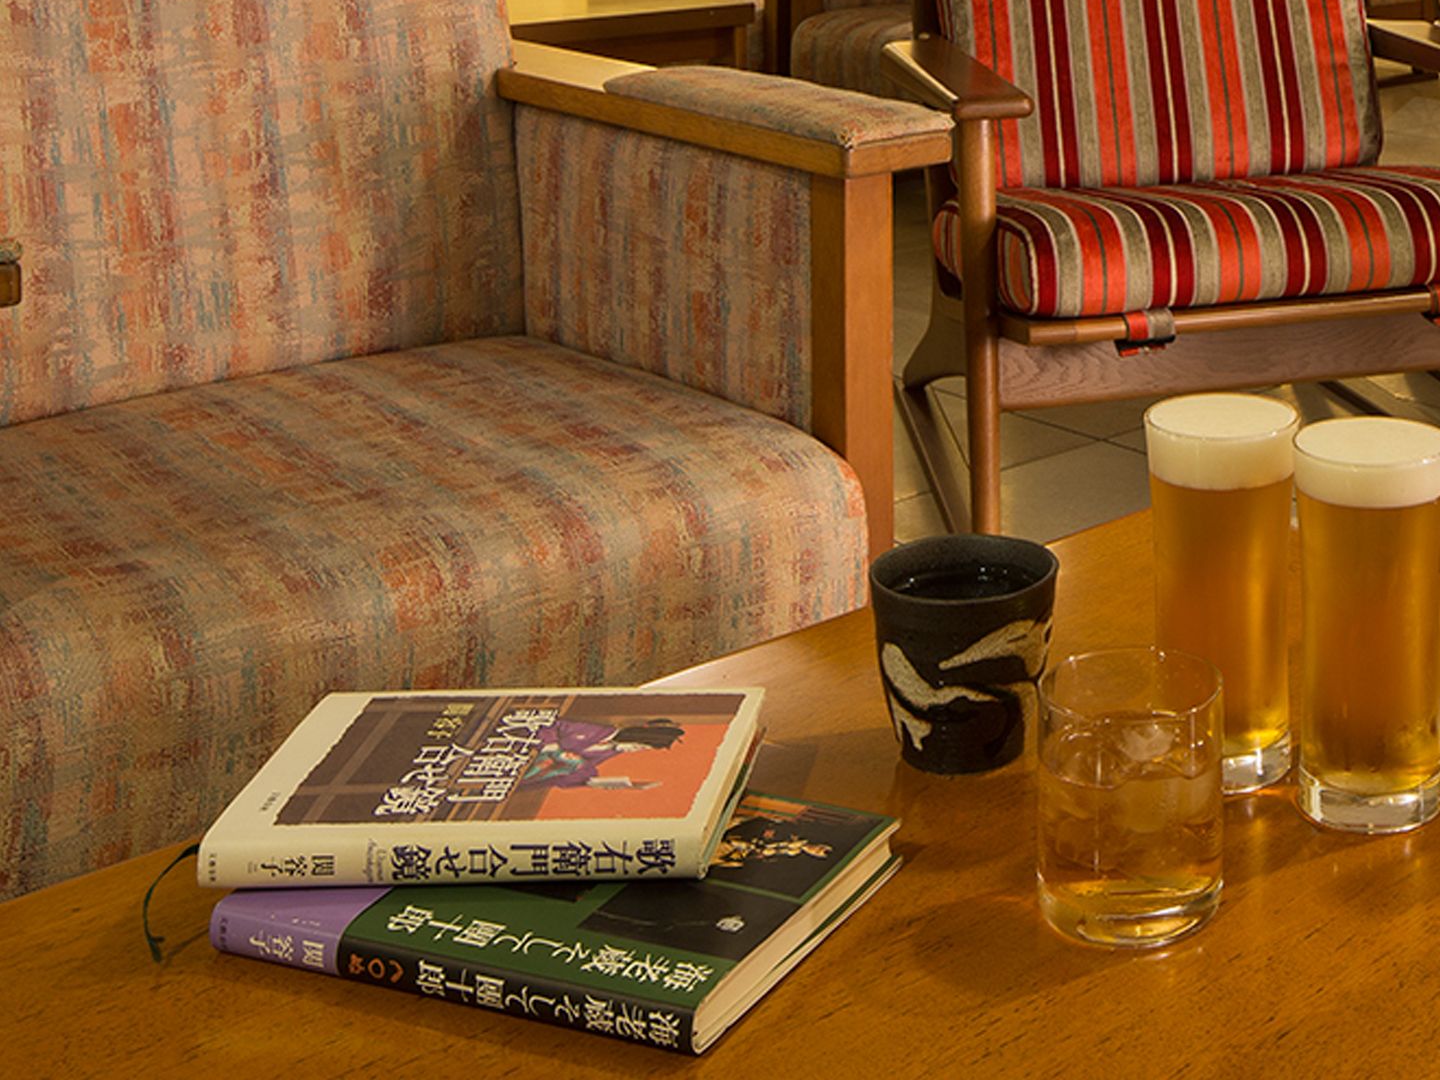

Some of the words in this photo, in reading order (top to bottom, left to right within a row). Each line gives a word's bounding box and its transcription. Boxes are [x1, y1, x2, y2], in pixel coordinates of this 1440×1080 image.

[446, 707, 559, 803] 歌右衛門
[261, 855, 335, 877] 関容子
[250, 929, 325, 968] 関容子
